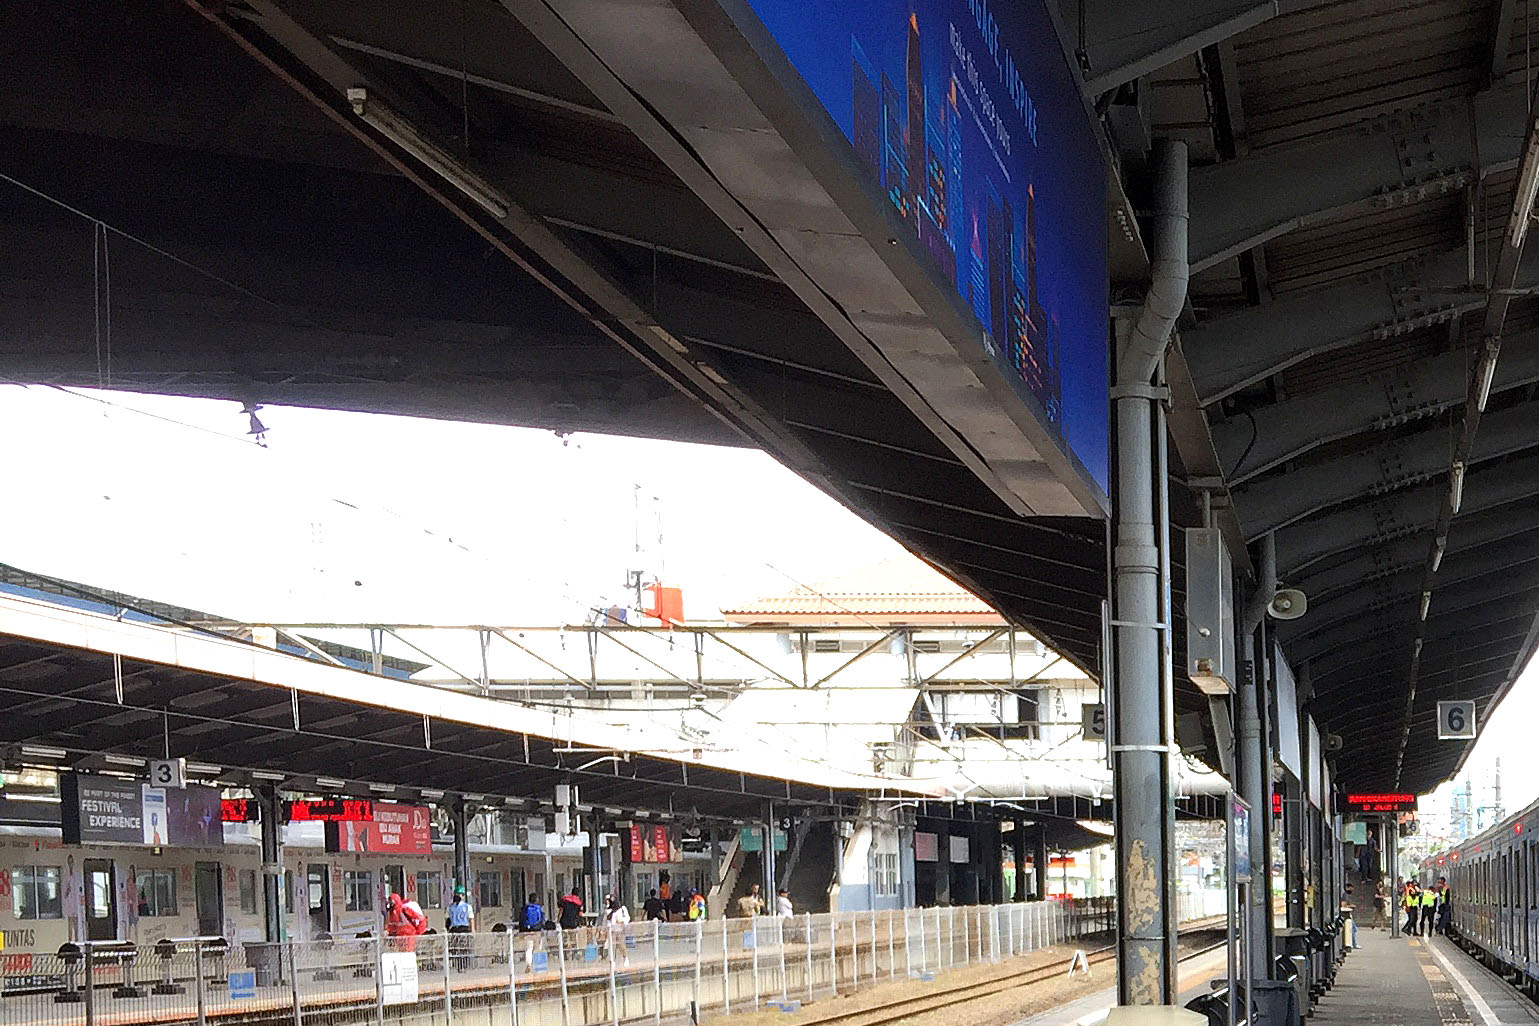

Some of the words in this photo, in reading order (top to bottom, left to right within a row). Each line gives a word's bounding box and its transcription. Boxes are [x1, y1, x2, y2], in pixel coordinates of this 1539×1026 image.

[1006, 49, 1037, 147] INSPIRE
[1092, 709, 1105, 734] 5
[1448, 707, 1464, 731] 6
[158, 764, 172, 783] 3
[82, 801, 122, 813] FESTIVAL
[89, 815, 141, 828] EXPERIENCE
[783, 817, 791, 829] 3
